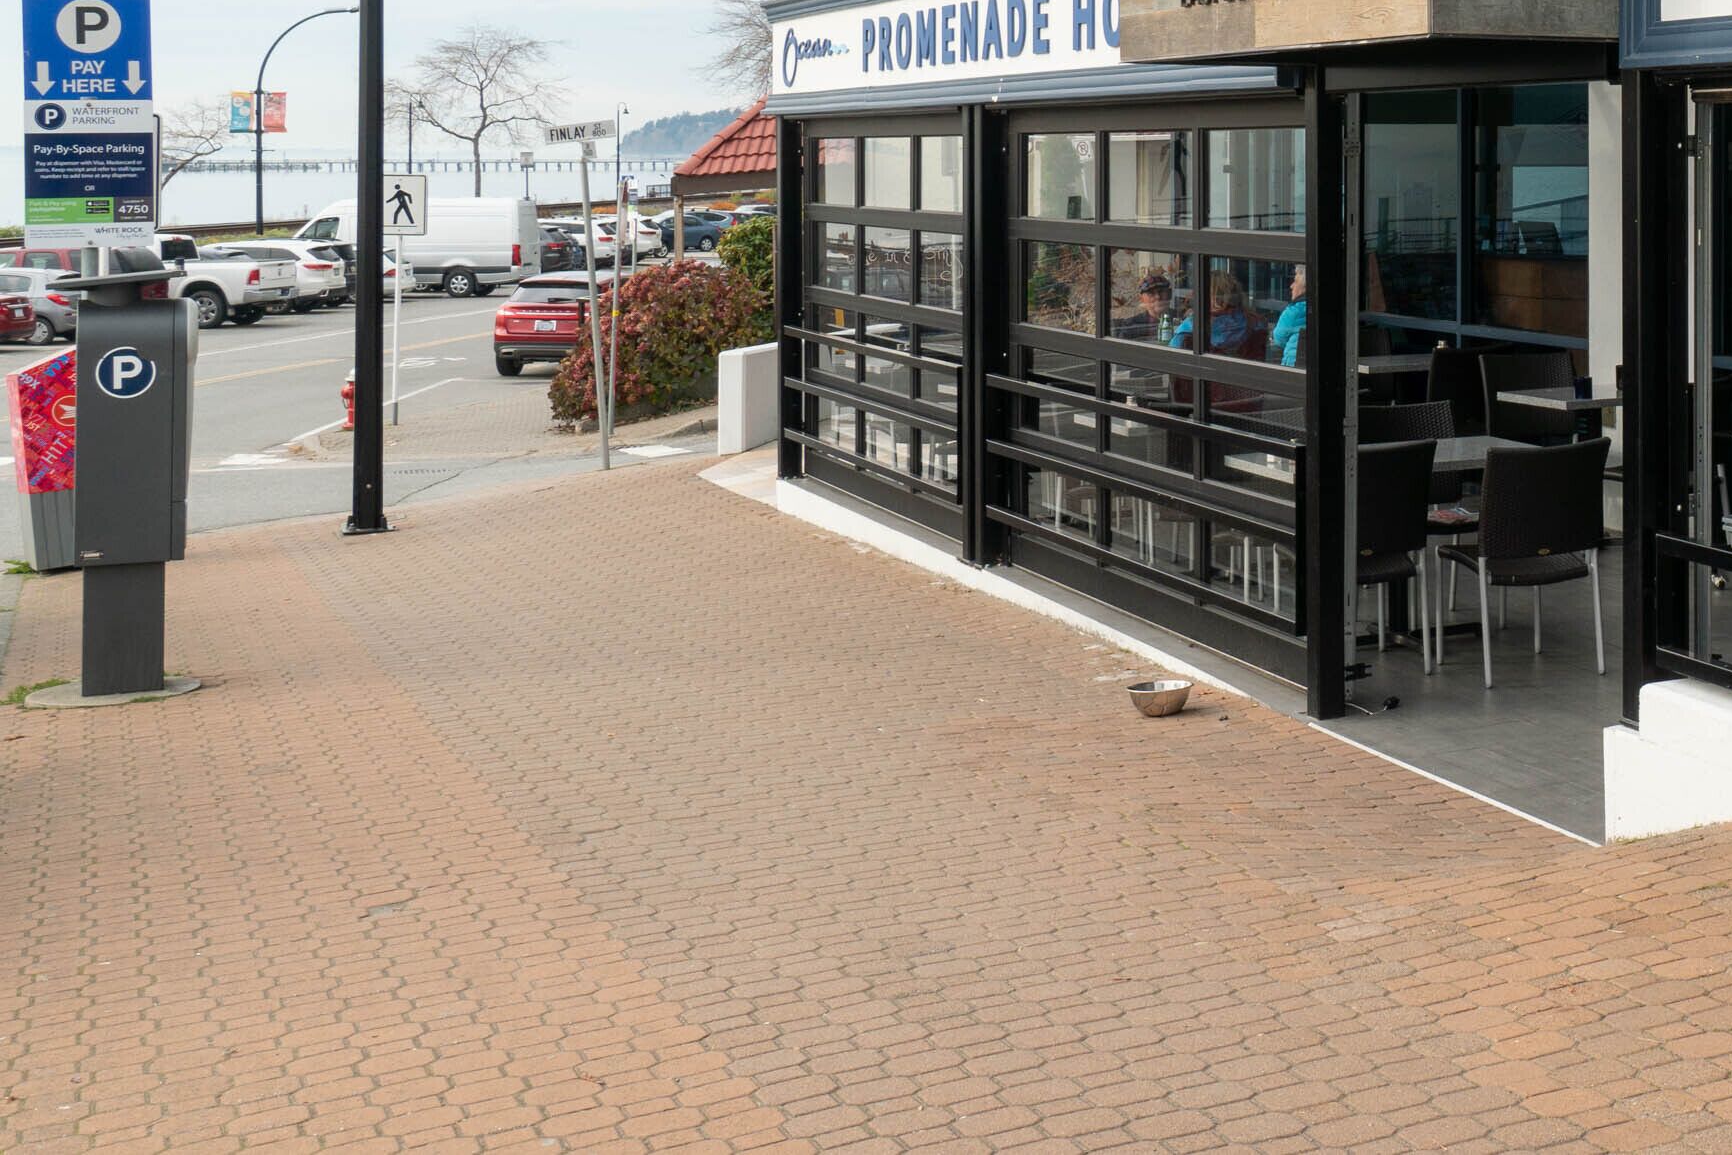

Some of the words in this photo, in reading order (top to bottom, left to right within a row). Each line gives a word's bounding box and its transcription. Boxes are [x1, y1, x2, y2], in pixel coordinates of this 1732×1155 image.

[76, 7, 109, 44] P
[783, 28, 833, 87] Ocean
[71, 60, 106, 75] PAY
[62, 78, 116, 93] HERE
[44, 109, 59, 125] P
[72, 107, 140, 116] WATERFRONT
[72, 117, 116, 125] PARKING
[550, 126, 586, 142] FINLAY
[33, 144, 104, 155] Pay-By-Space
[106, 144, 145, 154] Parking
[118, 204, 149, 214] 4750
[113, 356, 142, 390] P
